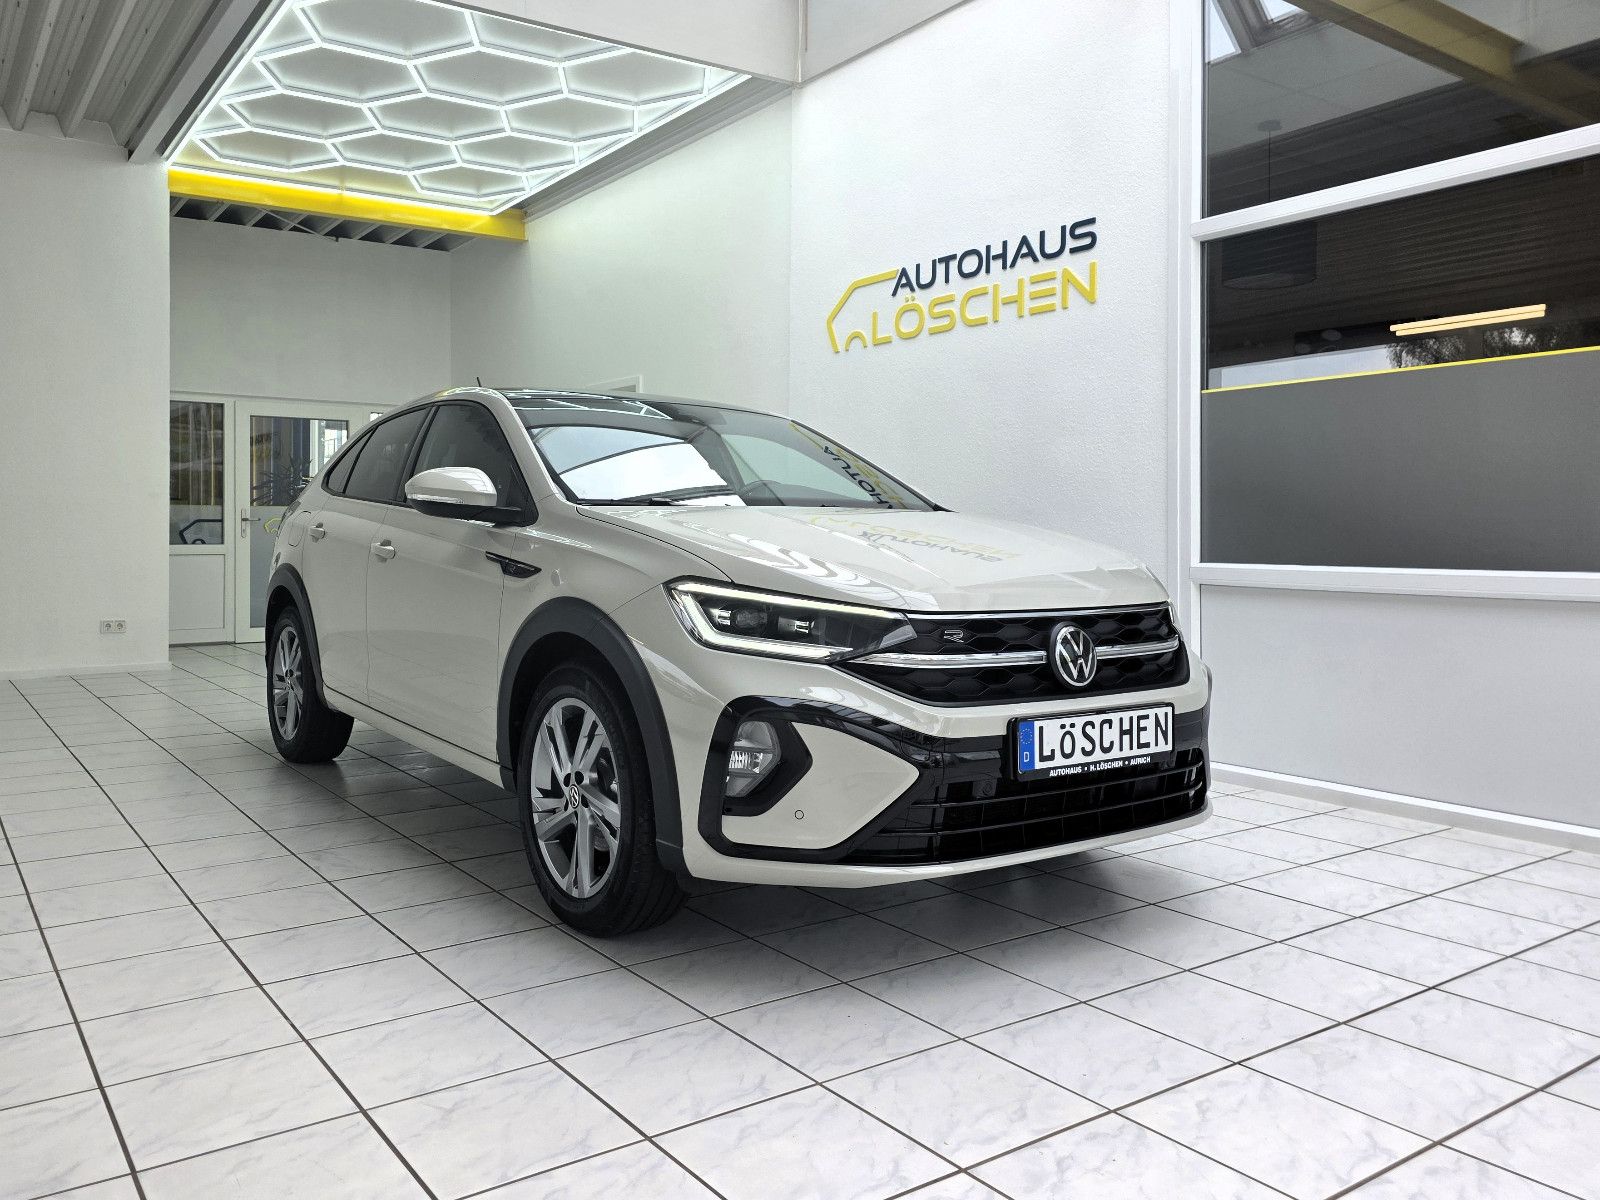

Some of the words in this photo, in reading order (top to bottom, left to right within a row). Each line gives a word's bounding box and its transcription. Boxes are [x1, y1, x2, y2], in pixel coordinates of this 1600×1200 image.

[892, 217, 1098, 297] AUTOHAUS
[872, 260, 1098, 346] LÖSCHEN
[1024, 751, 1030, 763] D
[1038, 711, 1169, 762] LÖSCHEN
[1049, 766, 1082, 776] AUTOHAUS
[1130, 756, 1150, 765] AURICH
